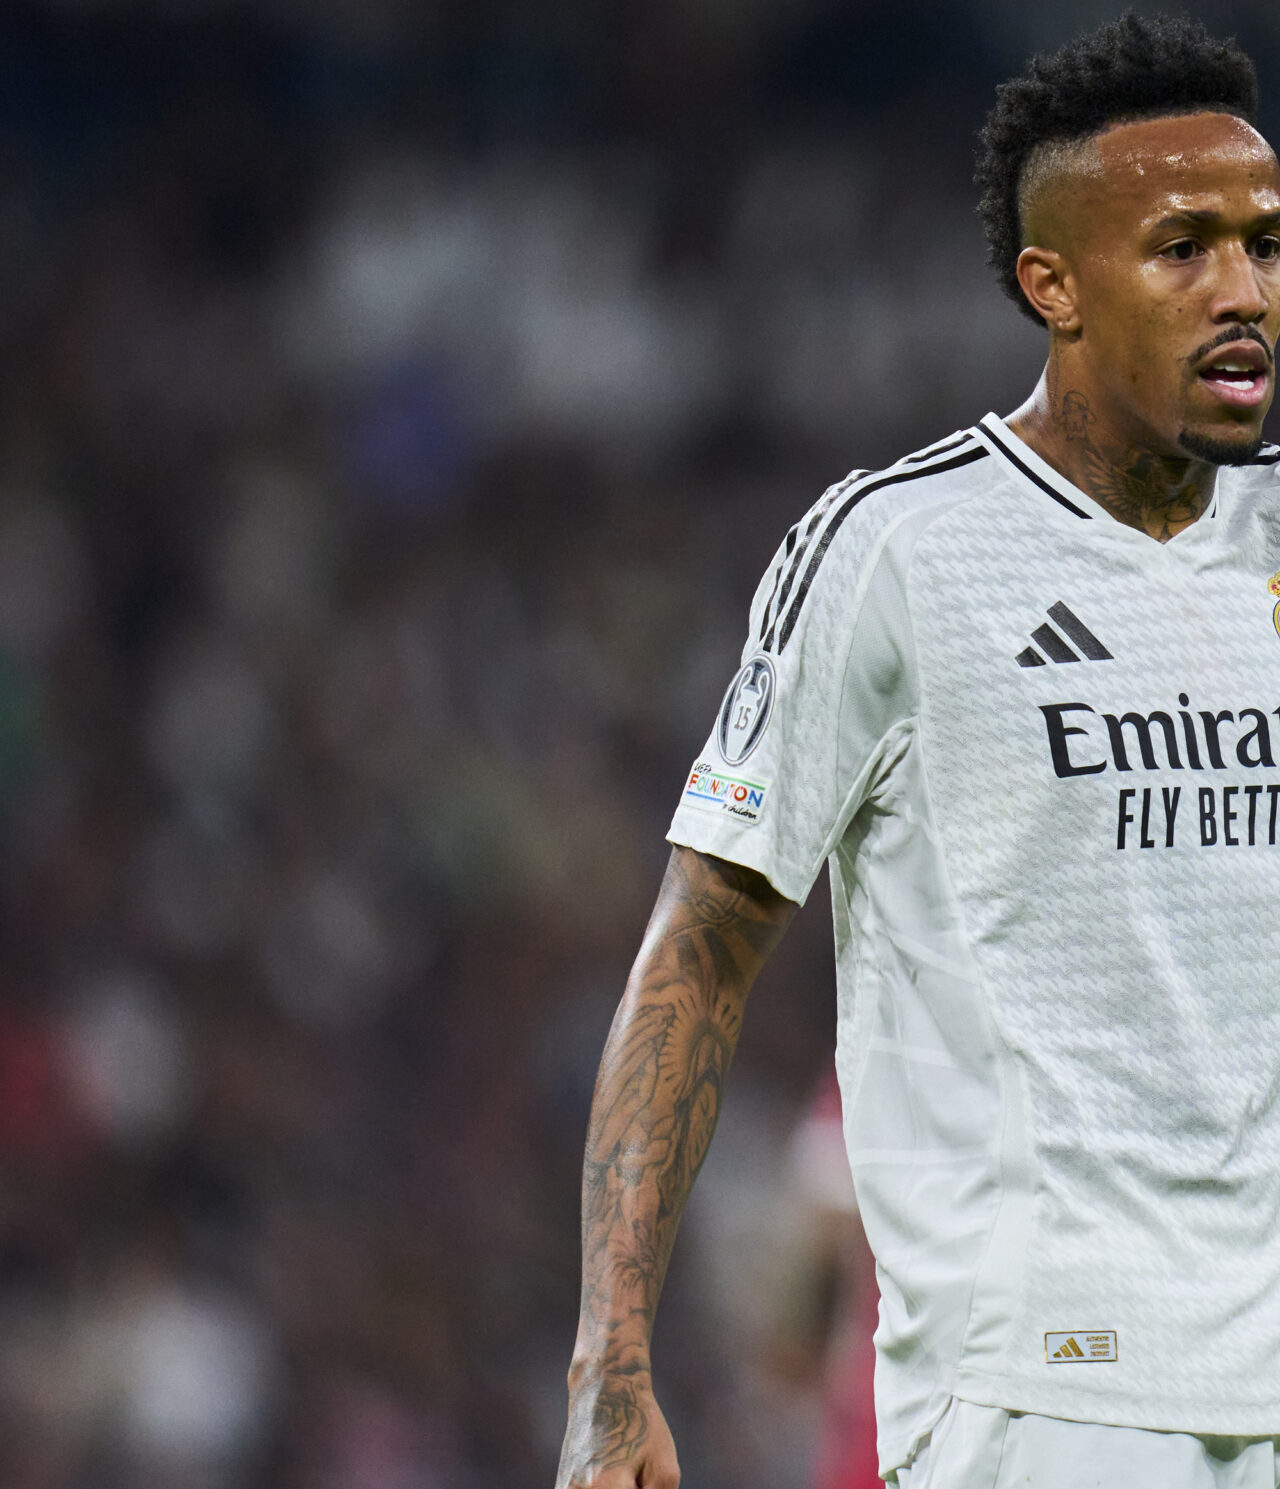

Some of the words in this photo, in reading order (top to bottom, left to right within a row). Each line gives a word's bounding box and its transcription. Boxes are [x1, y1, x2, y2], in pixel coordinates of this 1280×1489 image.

[734, 705, 751, 731] 15
[688, 774, 764, 809] FOUNDATION
[1117, 786, 1181, 850] FLY
